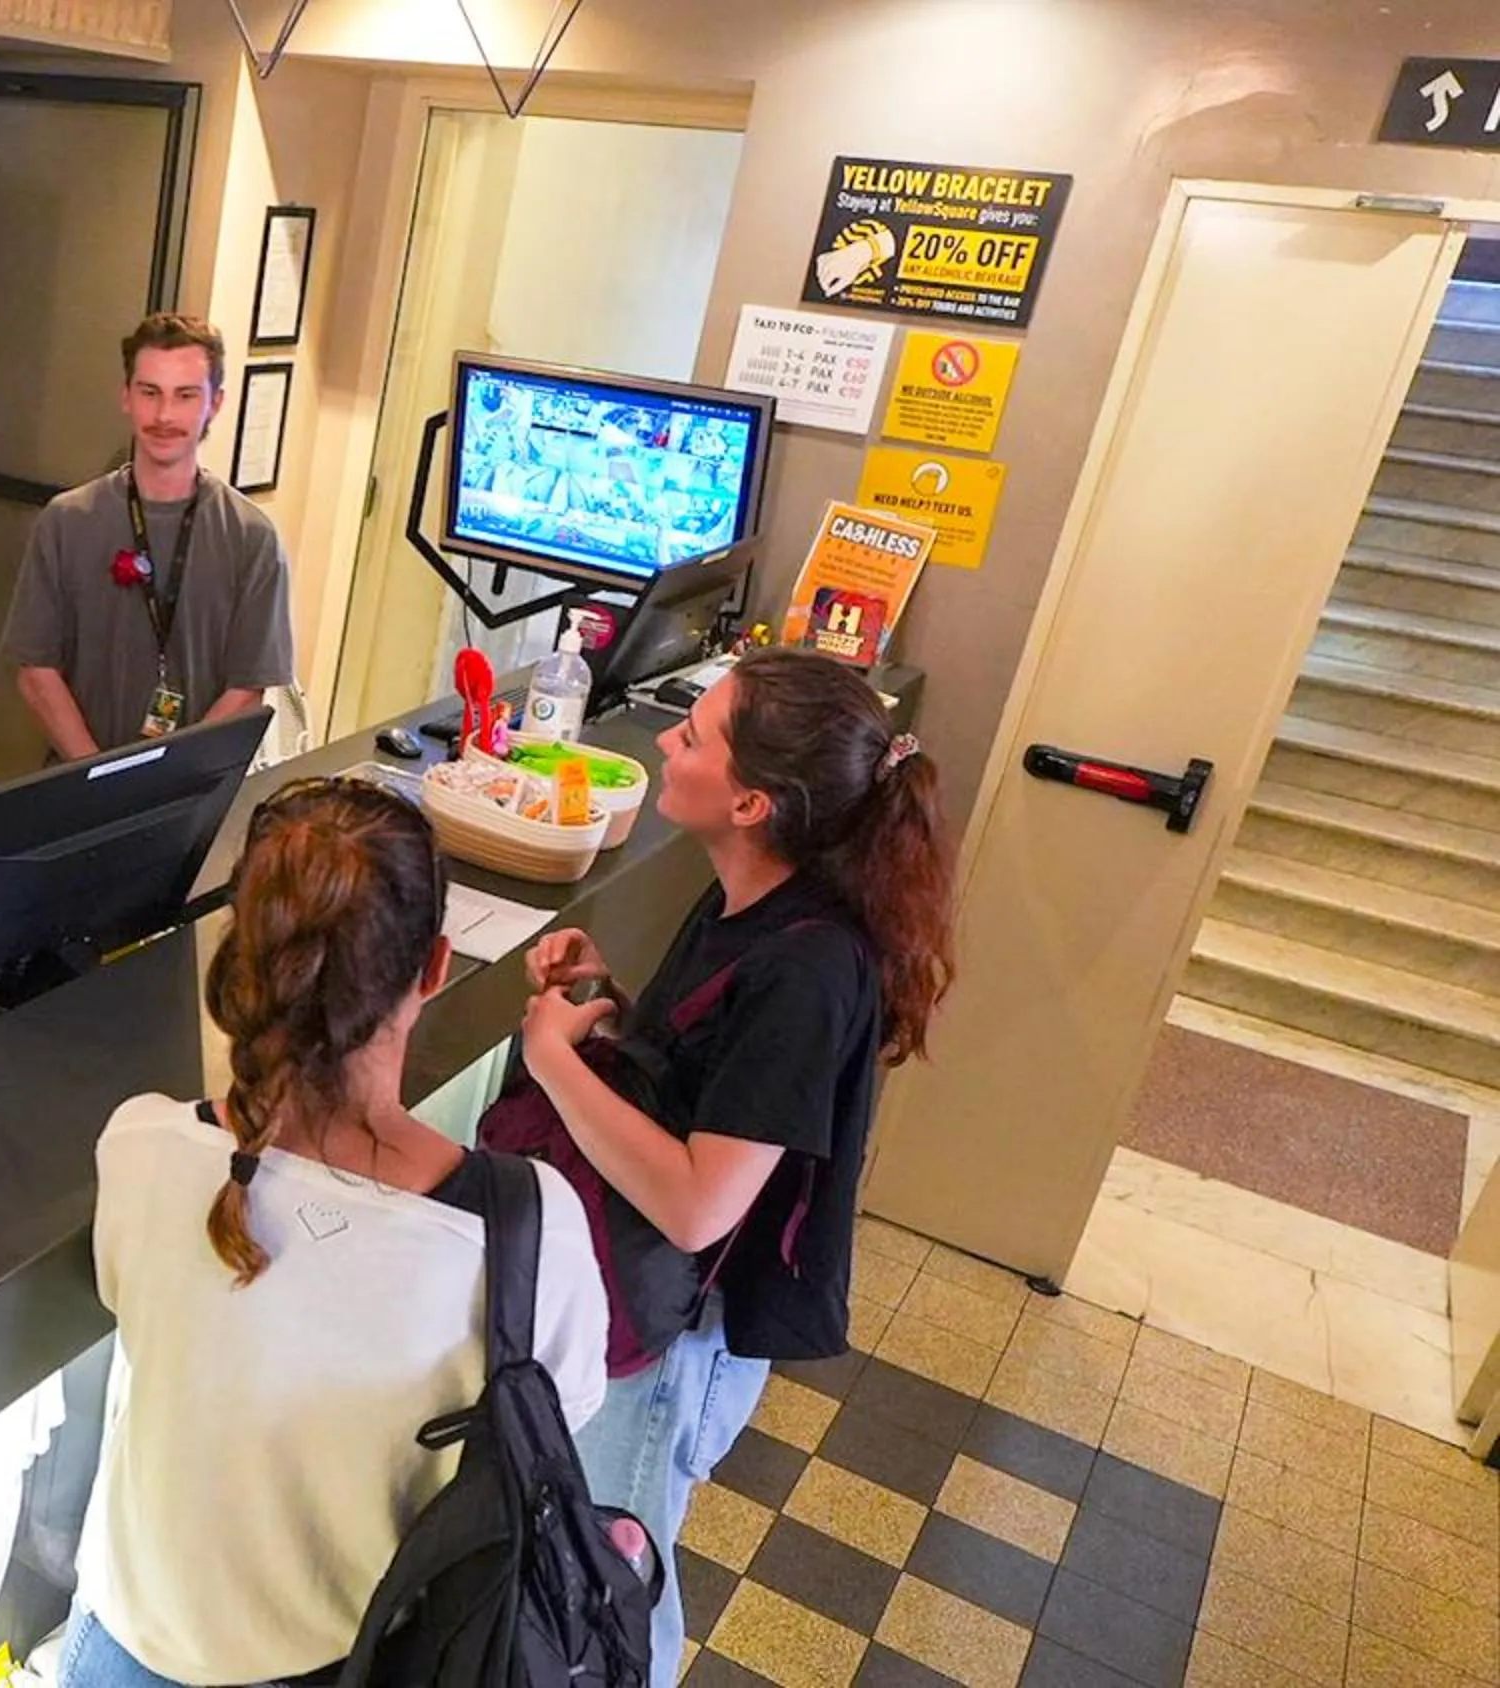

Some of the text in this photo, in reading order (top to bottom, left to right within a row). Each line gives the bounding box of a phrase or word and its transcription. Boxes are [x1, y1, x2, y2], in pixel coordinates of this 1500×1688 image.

[842, 165, 1052, 207] YELLOW BRACELET
[837, 193, 877, 214] Staying
[879, 197, 891, 211] at
[893, 199, 978, 221] YellowSquare
[978, 206, 1009, 225] gives
[908, 231, 1030, 270] 20% OFF
[754, 317, 777, 330] TAXI
[779, 320, 792, 332] TO
[812, 351, 837, 365] PAX
[810, 366, 834, 379] PAX
[807, 381, 830, 394] PAX
[933, 500, 956, 513] TEXT
[831, 517, 921, 559] CASHLESS
